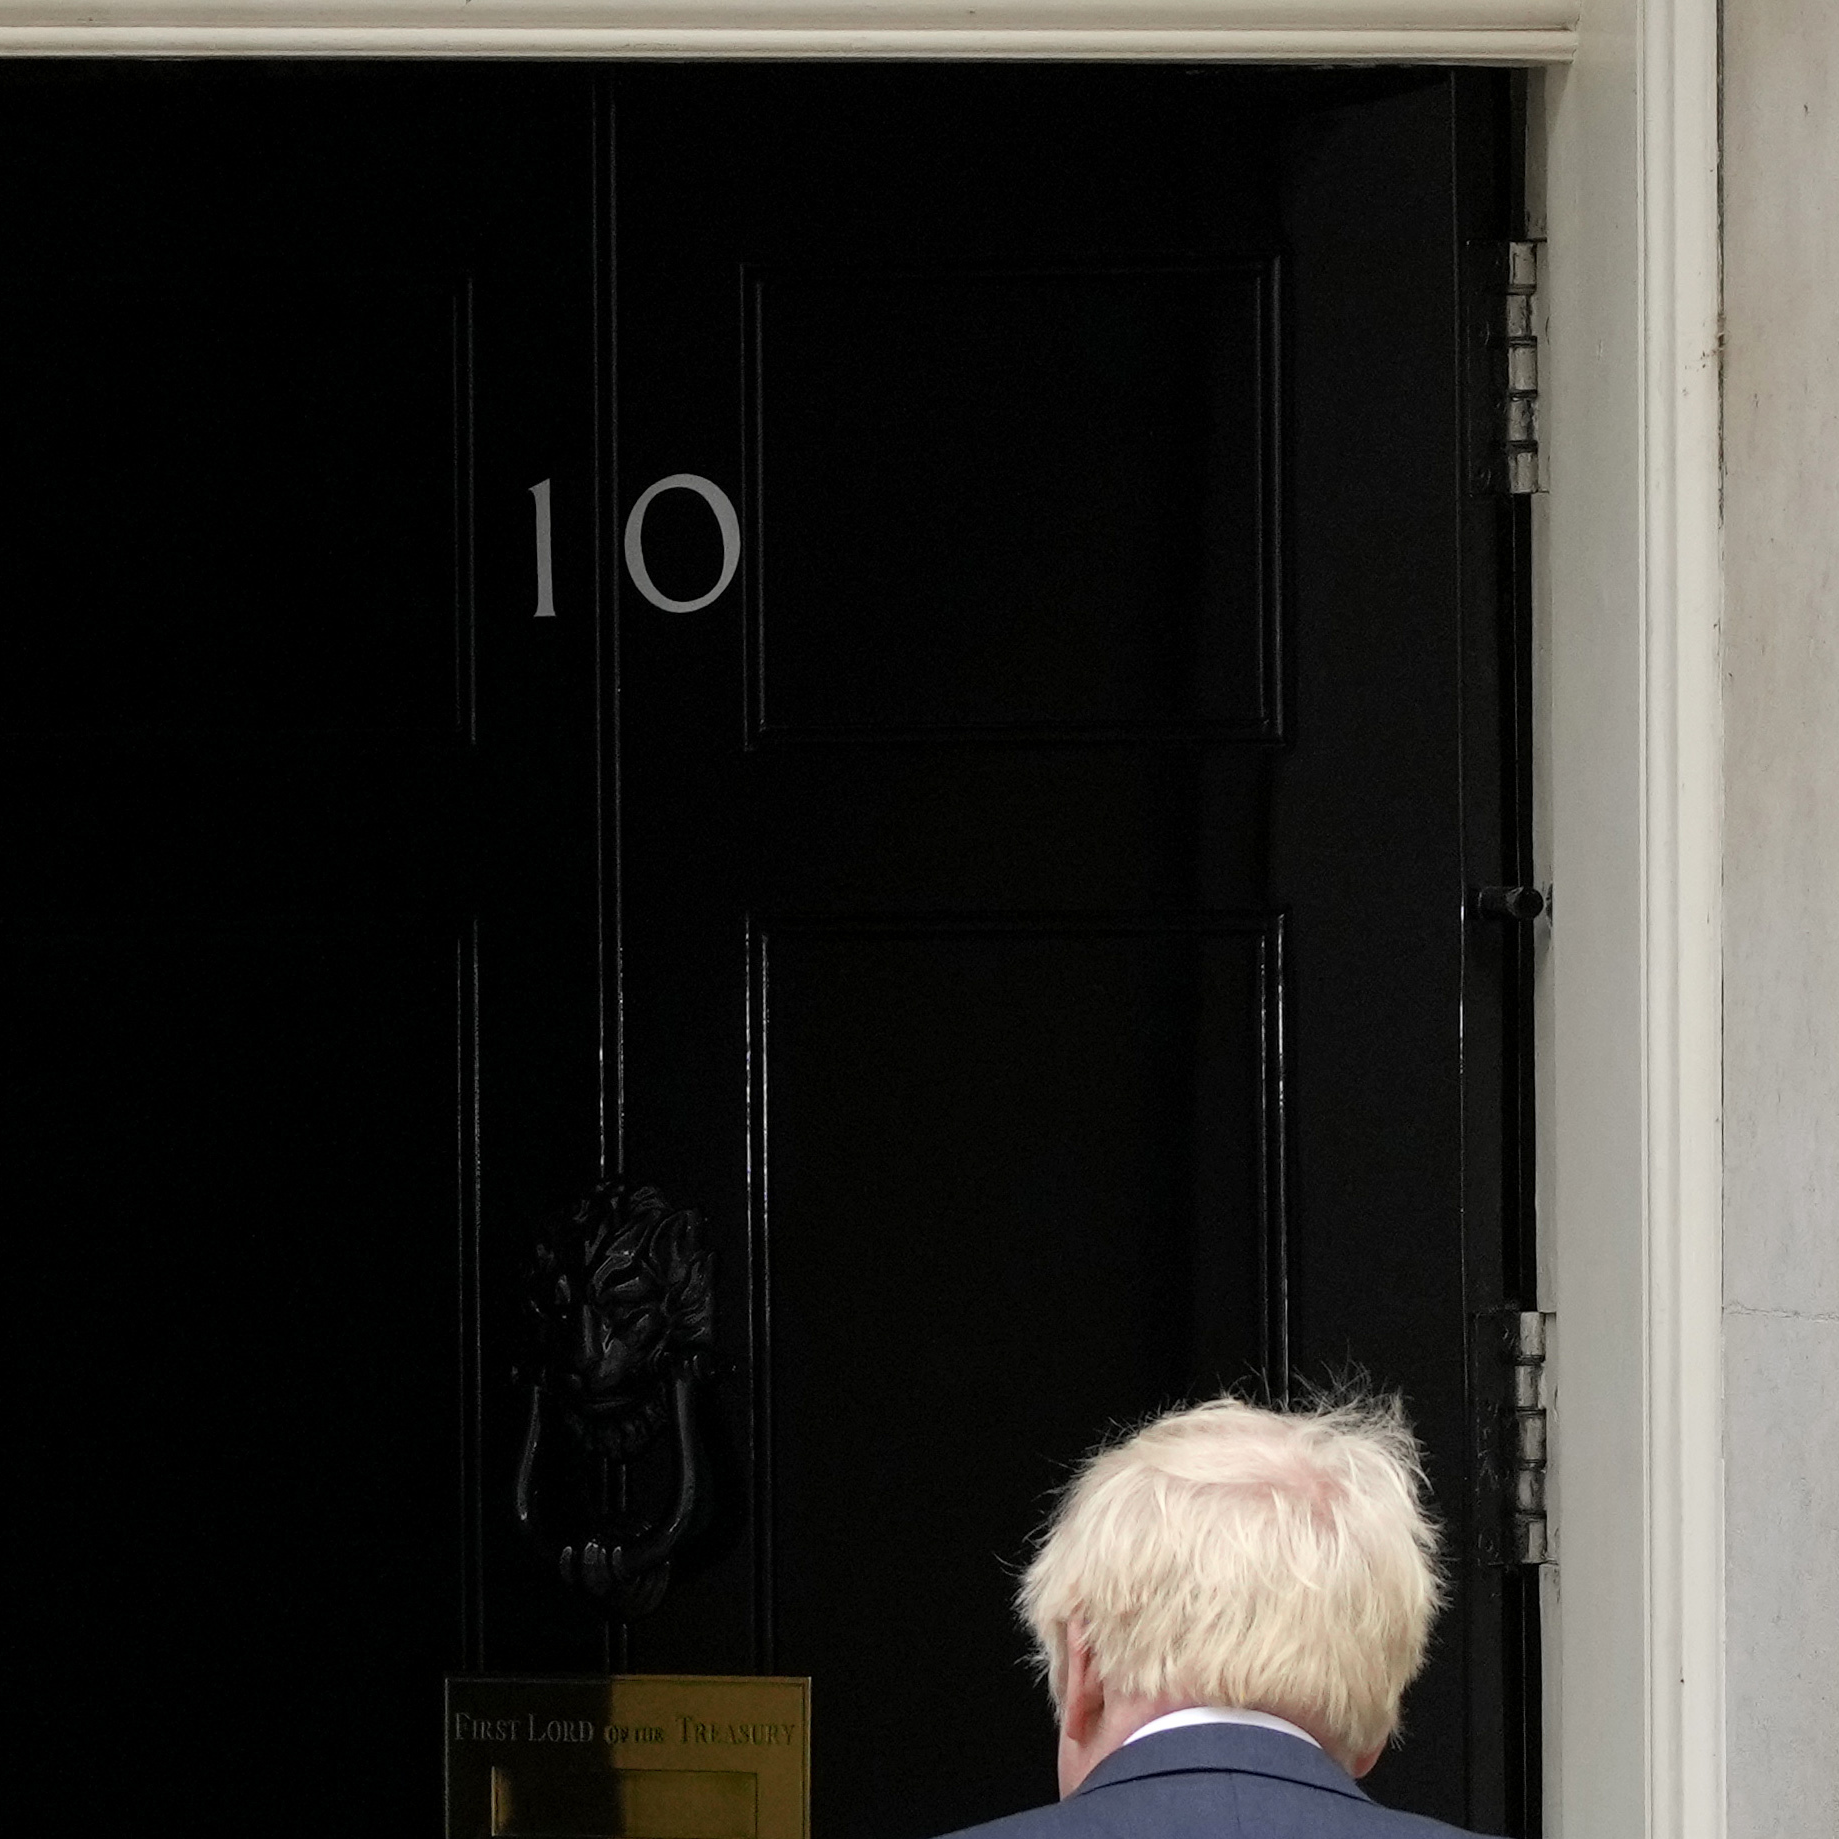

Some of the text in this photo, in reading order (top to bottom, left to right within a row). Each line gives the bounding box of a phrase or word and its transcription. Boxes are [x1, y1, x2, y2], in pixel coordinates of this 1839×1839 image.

[528, 473, 741, 617] 10
[455, 1712, 520, 1741] FIRST
[528, 1713, 594, 1742] LORD
[675, 1715, 796, 1745] TREASURY
